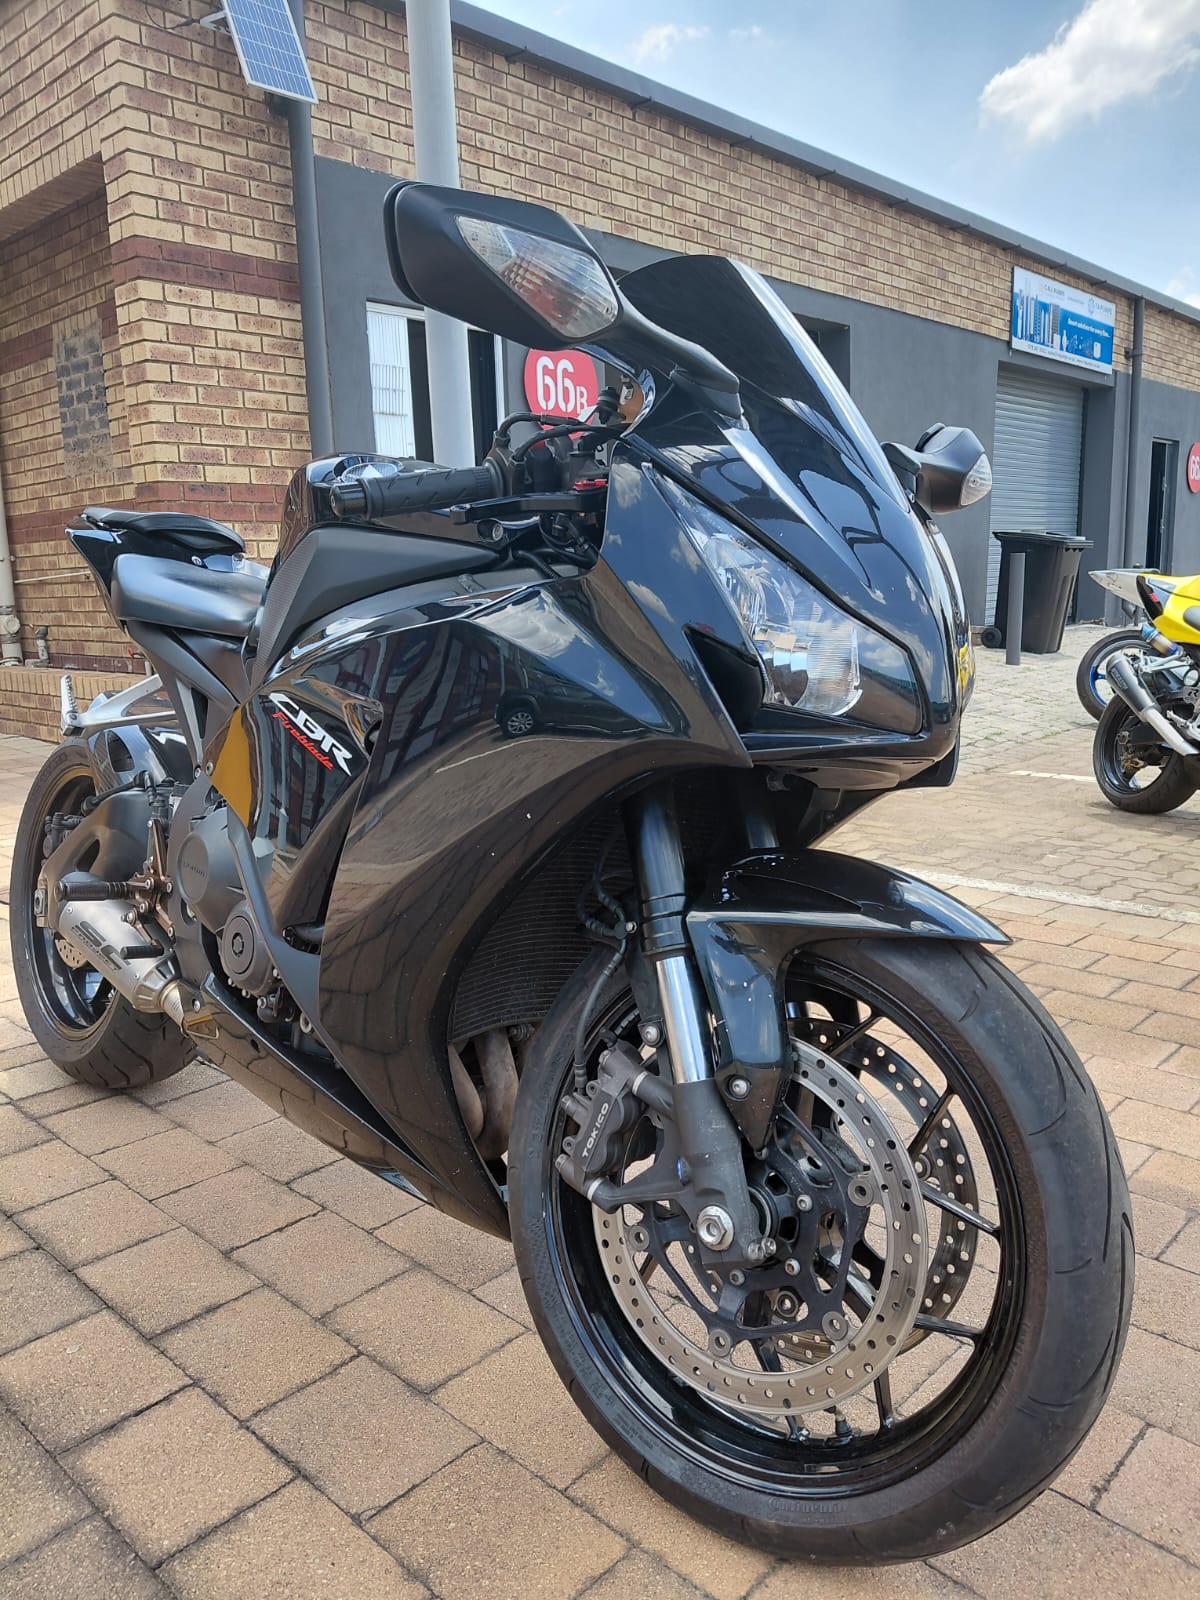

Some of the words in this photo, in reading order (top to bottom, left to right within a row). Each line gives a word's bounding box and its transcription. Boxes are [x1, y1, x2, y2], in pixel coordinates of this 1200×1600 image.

[536, 355, 588, 415] 66B
[268, 692, 353, 777] CBR
[272, 711, 334, 771] Fireblade
[582, 1102, 609, 1158] TOKICO
